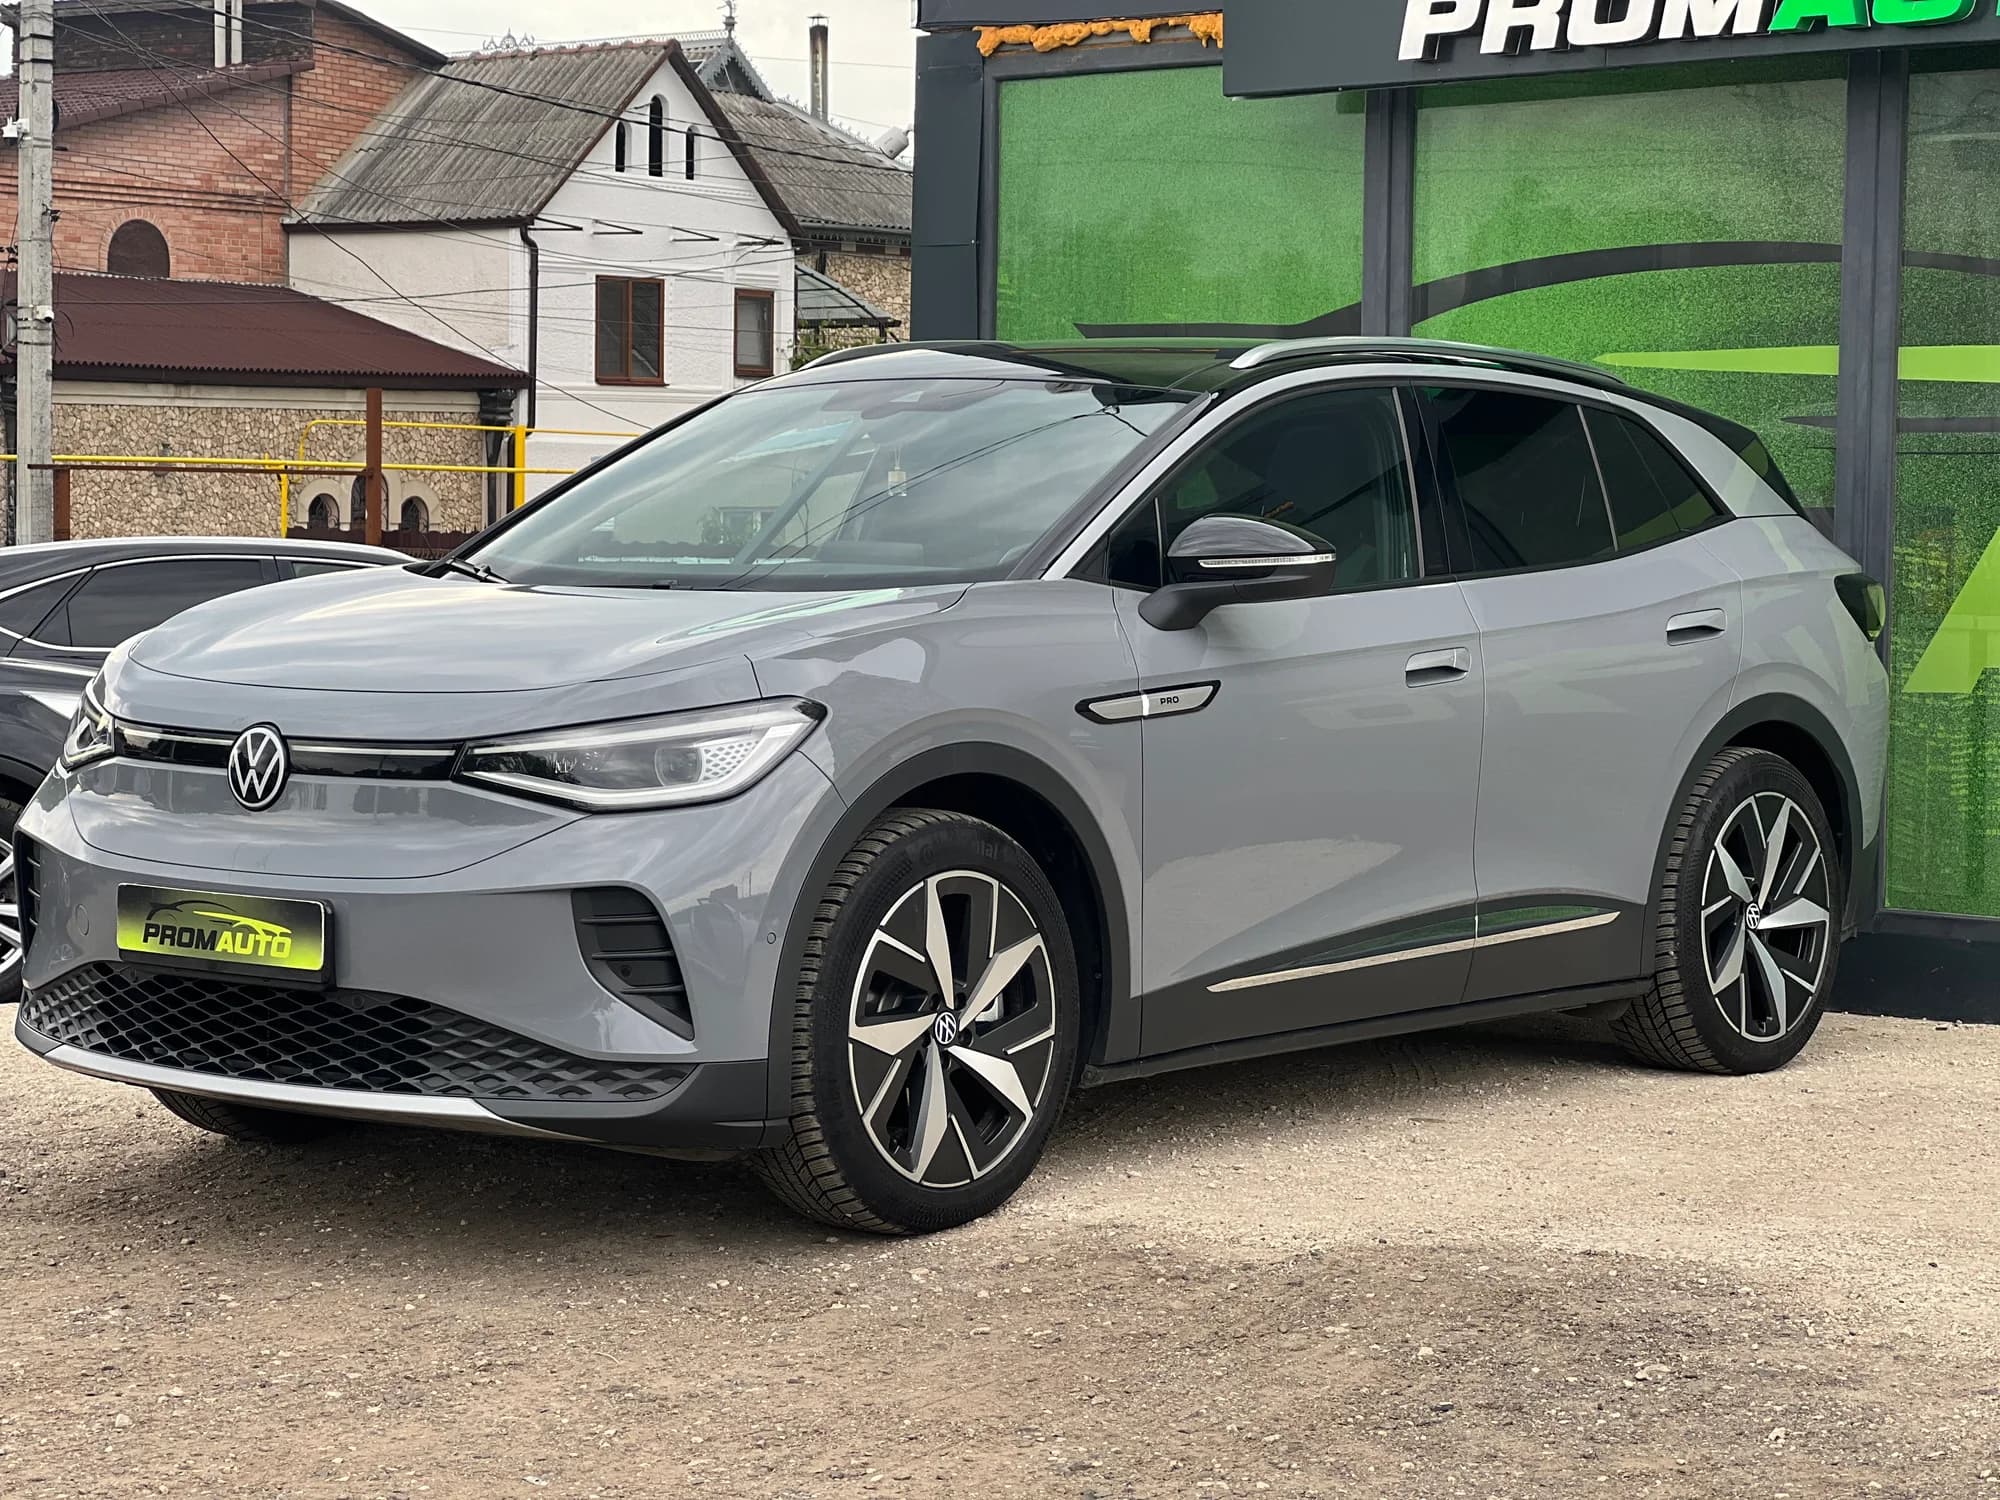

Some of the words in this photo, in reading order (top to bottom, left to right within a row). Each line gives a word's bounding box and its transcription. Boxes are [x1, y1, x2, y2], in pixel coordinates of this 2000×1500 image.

[1397, 0, 2000, 61] PROM
[1160, 696, 1180, 705] PRO
[230, 729, 283, 803] VW
[143, 923, 292, 958] PROMAUTO
